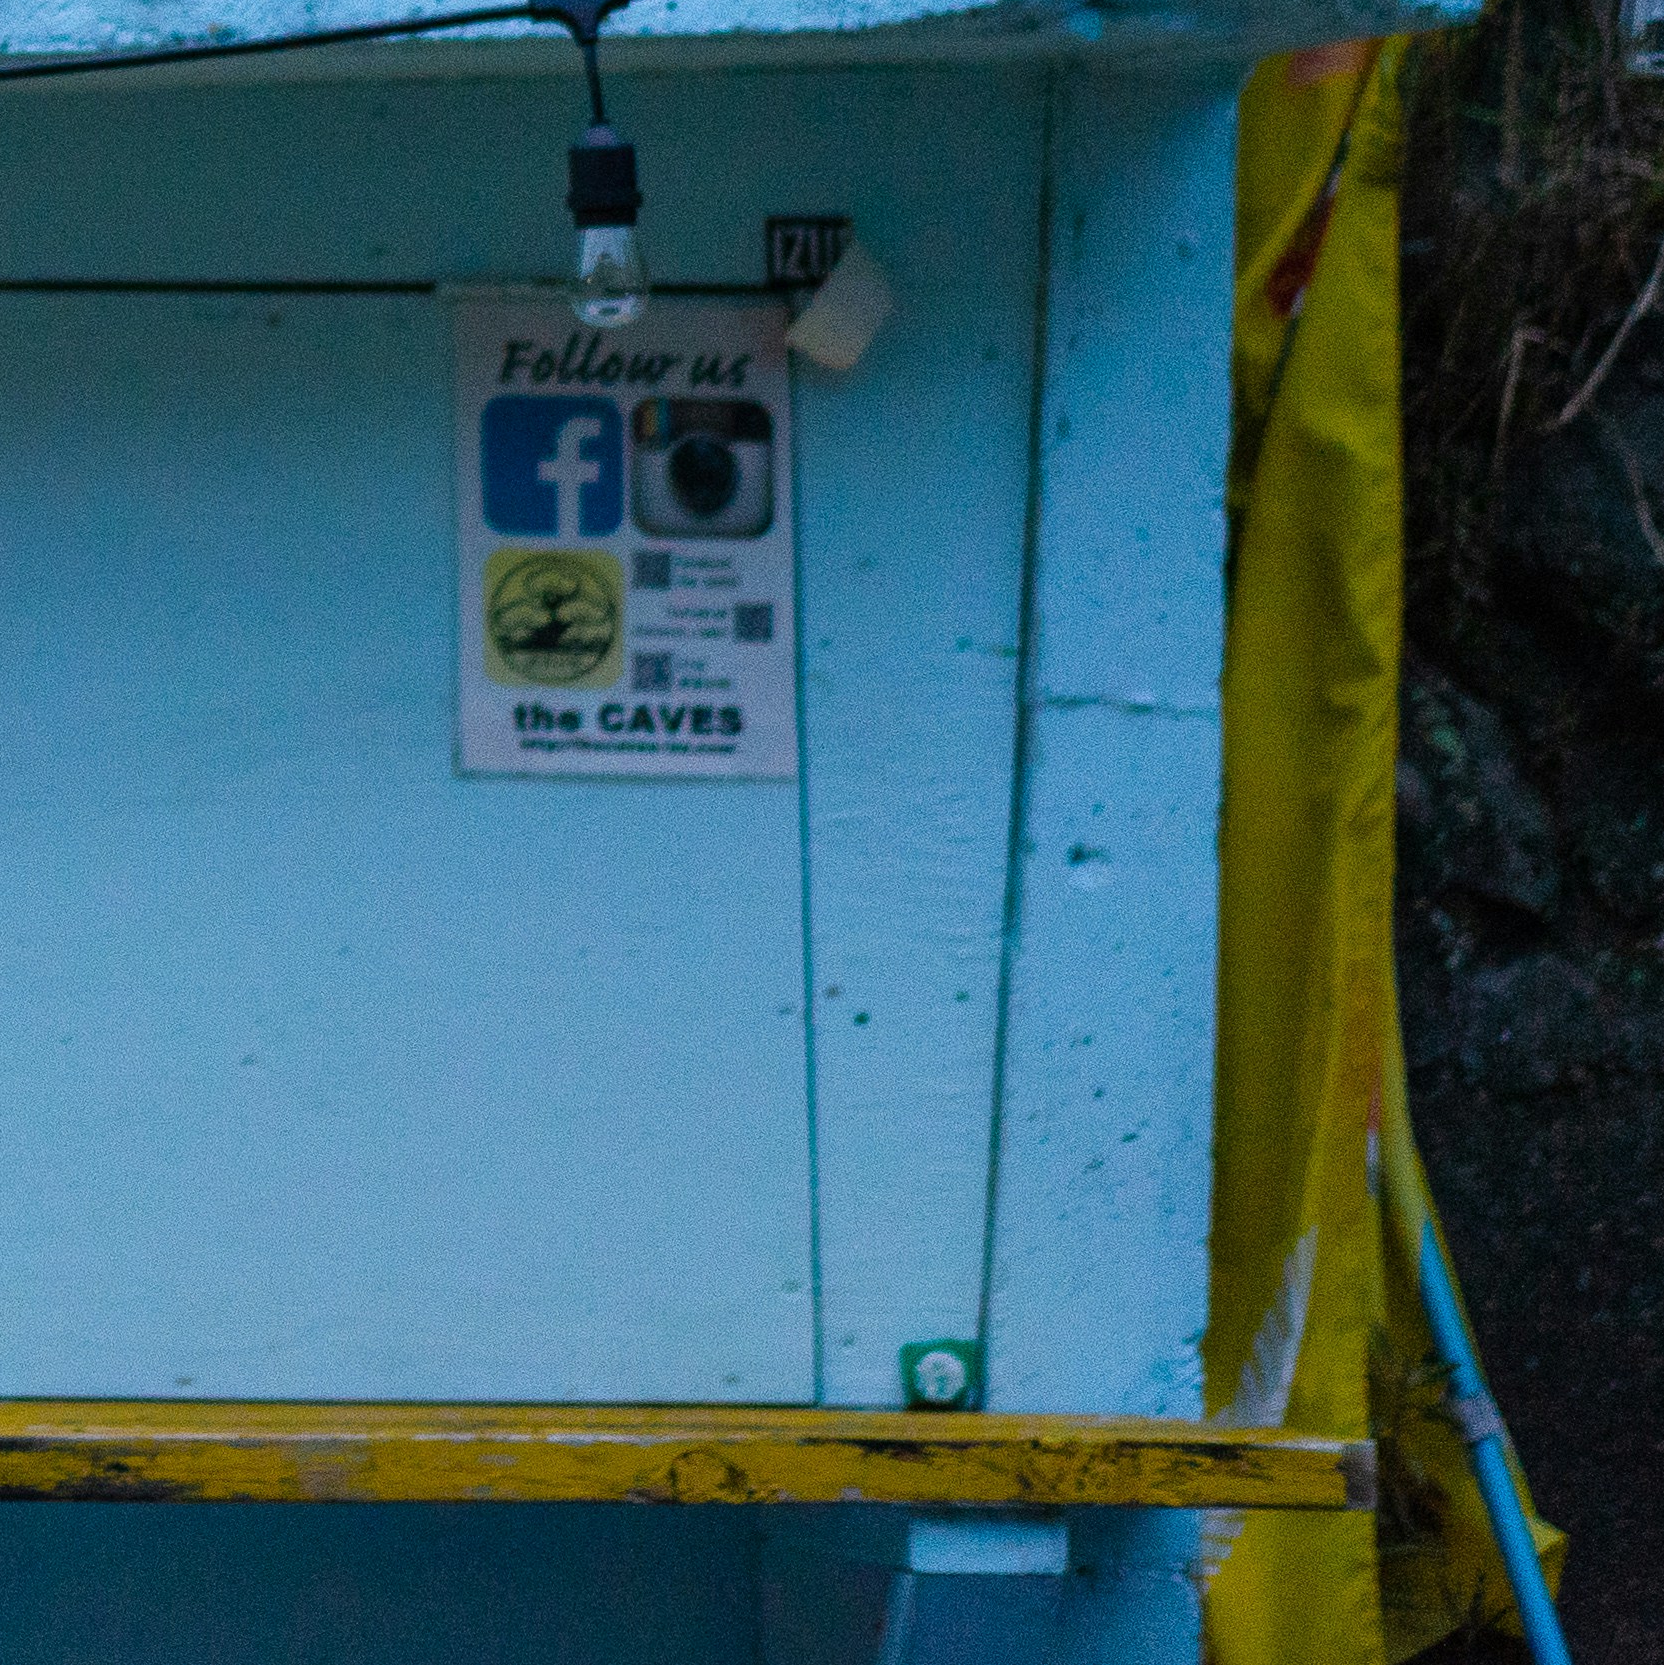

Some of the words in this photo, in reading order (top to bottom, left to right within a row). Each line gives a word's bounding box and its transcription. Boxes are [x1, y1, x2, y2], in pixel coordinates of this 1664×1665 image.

[499, 331, 676, 386] Follow
[689, 354, 751, 386] us
[514, 702, 583, 732] the
[597, 702, 743, 736] CAVES
